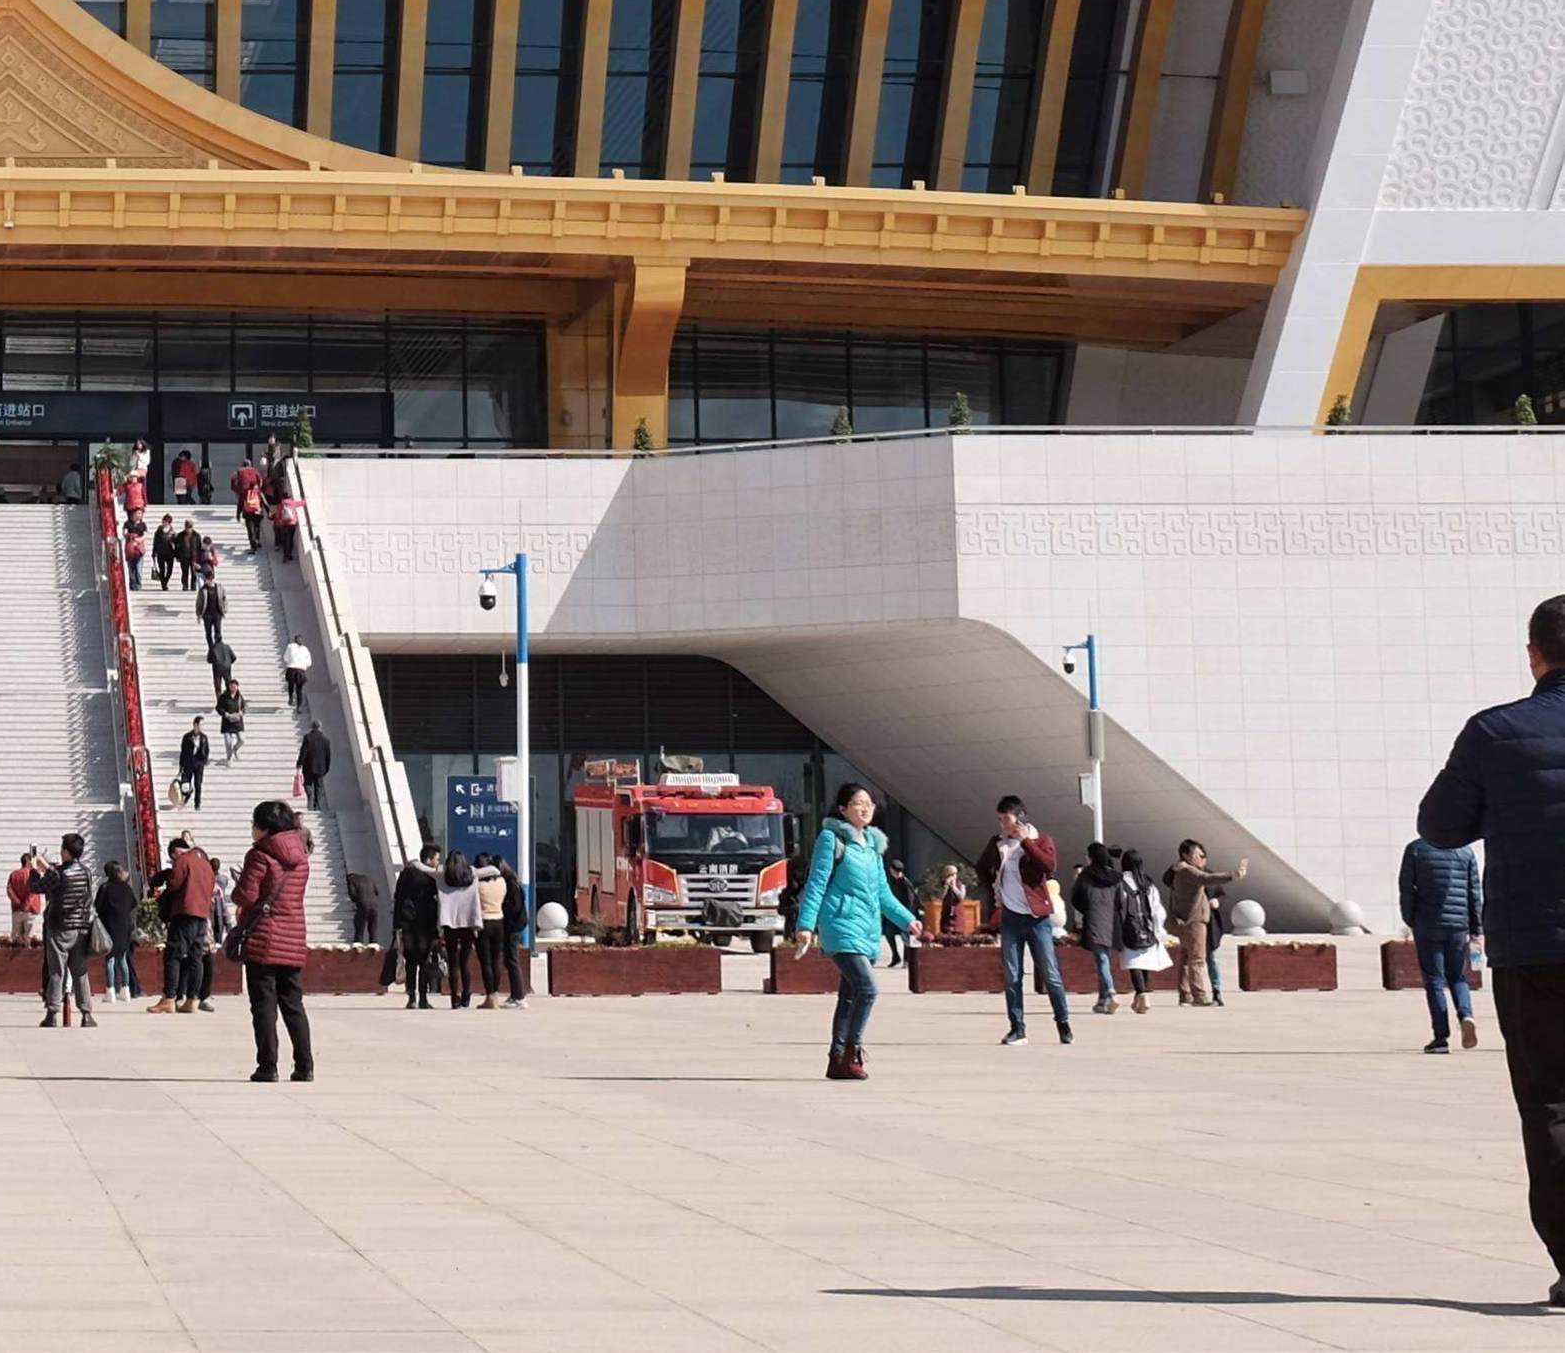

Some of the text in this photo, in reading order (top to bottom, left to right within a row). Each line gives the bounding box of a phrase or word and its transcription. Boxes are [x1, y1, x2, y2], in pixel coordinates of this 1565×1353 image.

[260, 404, 316, 418] 西进站口
[698, 863, 739, 875] 云南消防
